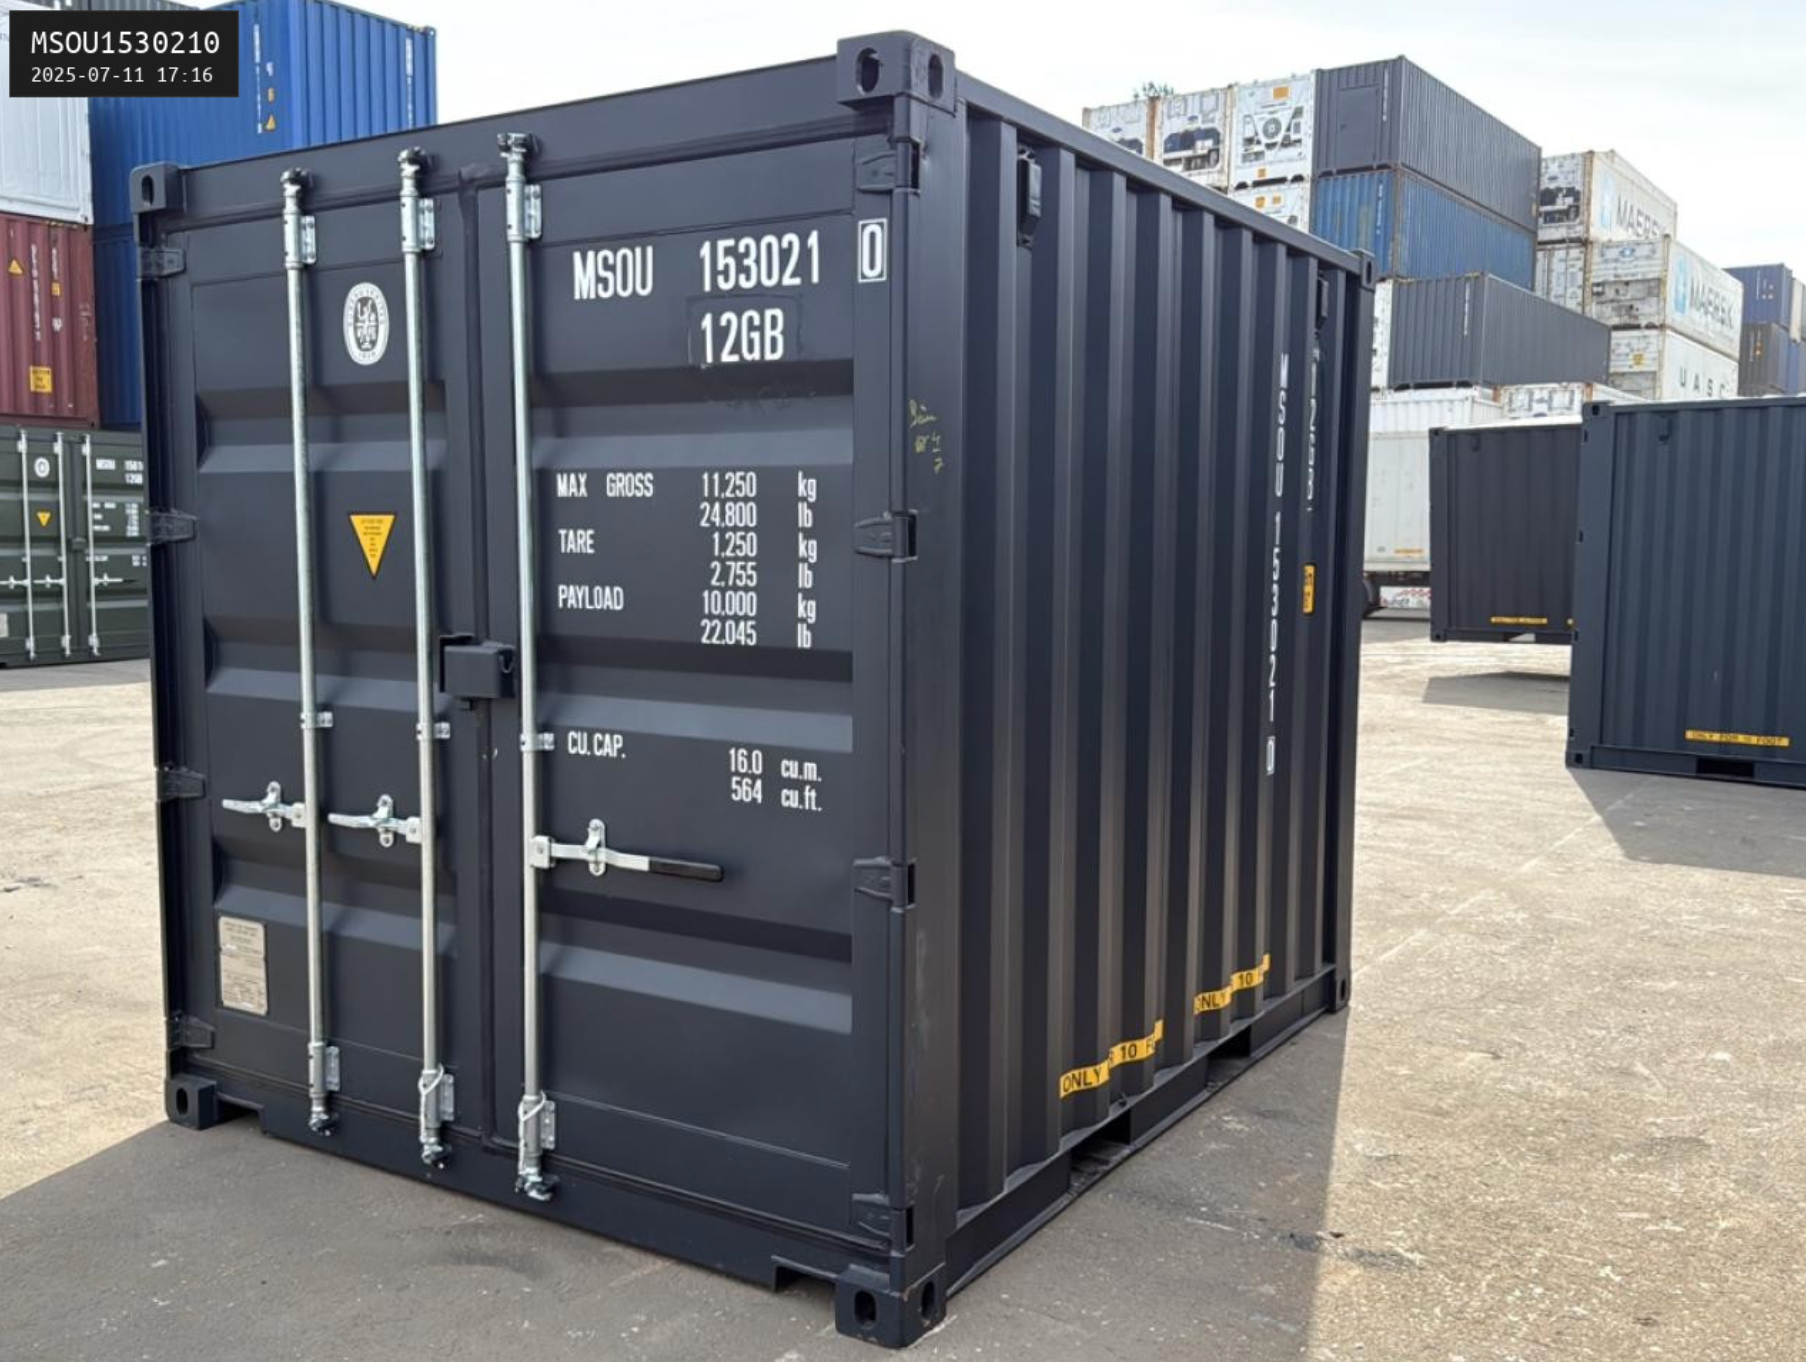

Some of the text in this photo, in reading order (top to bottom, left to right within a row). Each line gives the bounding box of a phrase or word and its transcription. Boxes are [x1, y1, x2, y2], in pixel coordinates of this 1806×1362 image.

[573, 223, 882, 301] MSOU 153021 0
[700, 307, 785, 364] 12GB
[556, 473, 588, 498] MAX
[606, 472, 654, 498] GROSS
[797, 472, 818, 502] kg
[797, 502, 815, 529] lb
[558, 529, 595, 553] TARE
[798, 533, 818, 562] kg
[797, 562, 816, 589] lb
[558, 585, 625, 611] PAYLOAD
[797, 593, 817, 624] kg
[1268, 511, 1281, 722] 153021
[797, 622, 815, 649] lb
[728, 748, 763, 775] 16.0
[780, 759, 822, 782] cu.m.
[731, 777, 823, 812] 564 cu.ft.
[1239, 973, 1254, 986] 10
[1063, 1066, 1102, 1093] ONLY
[1120, 1042, 1137, 1060] 10
